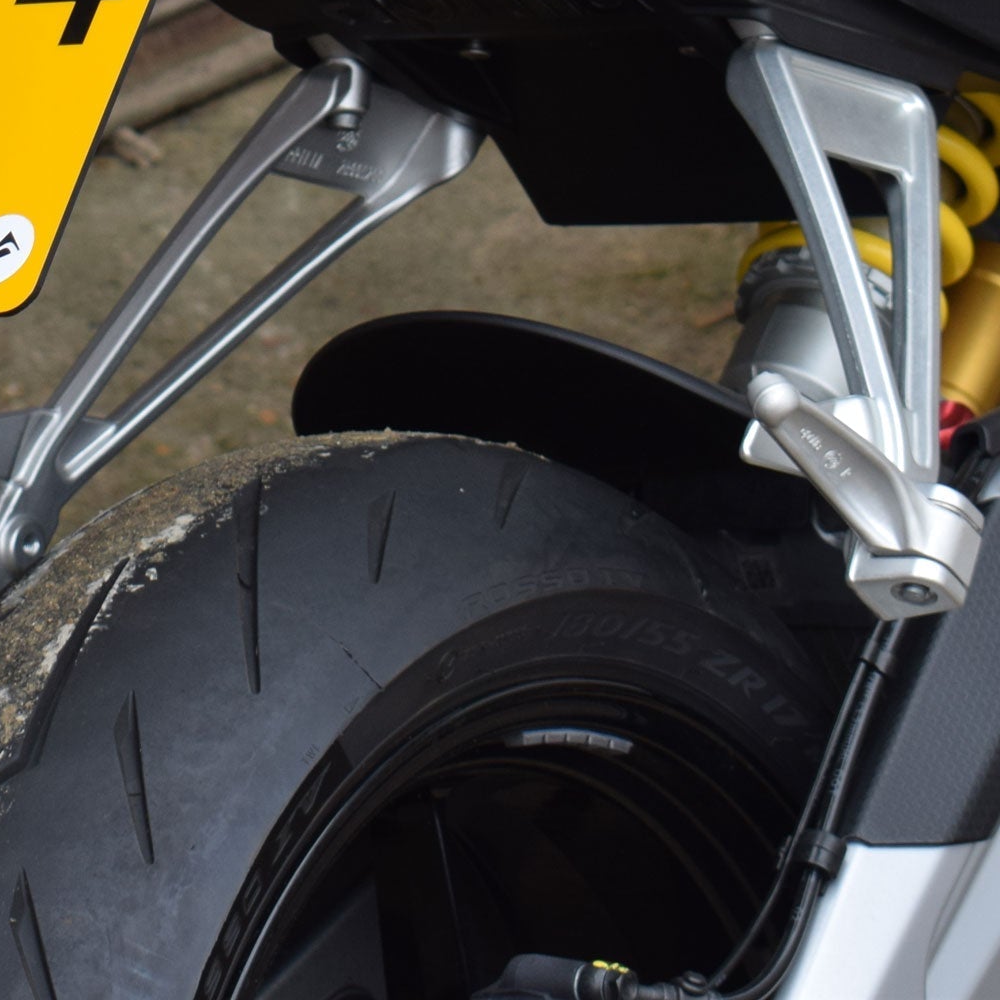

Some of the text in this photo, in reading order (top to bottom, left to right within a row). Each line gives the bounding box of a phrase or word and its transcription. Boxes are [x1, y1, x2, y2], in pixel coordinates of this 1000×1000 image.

[459, 567, 590, 614] ROSSO
[548, 612, 702, 656] 180/55
[699, 649, 767, 699] ZR
[760, 693, 810, 728] 17
